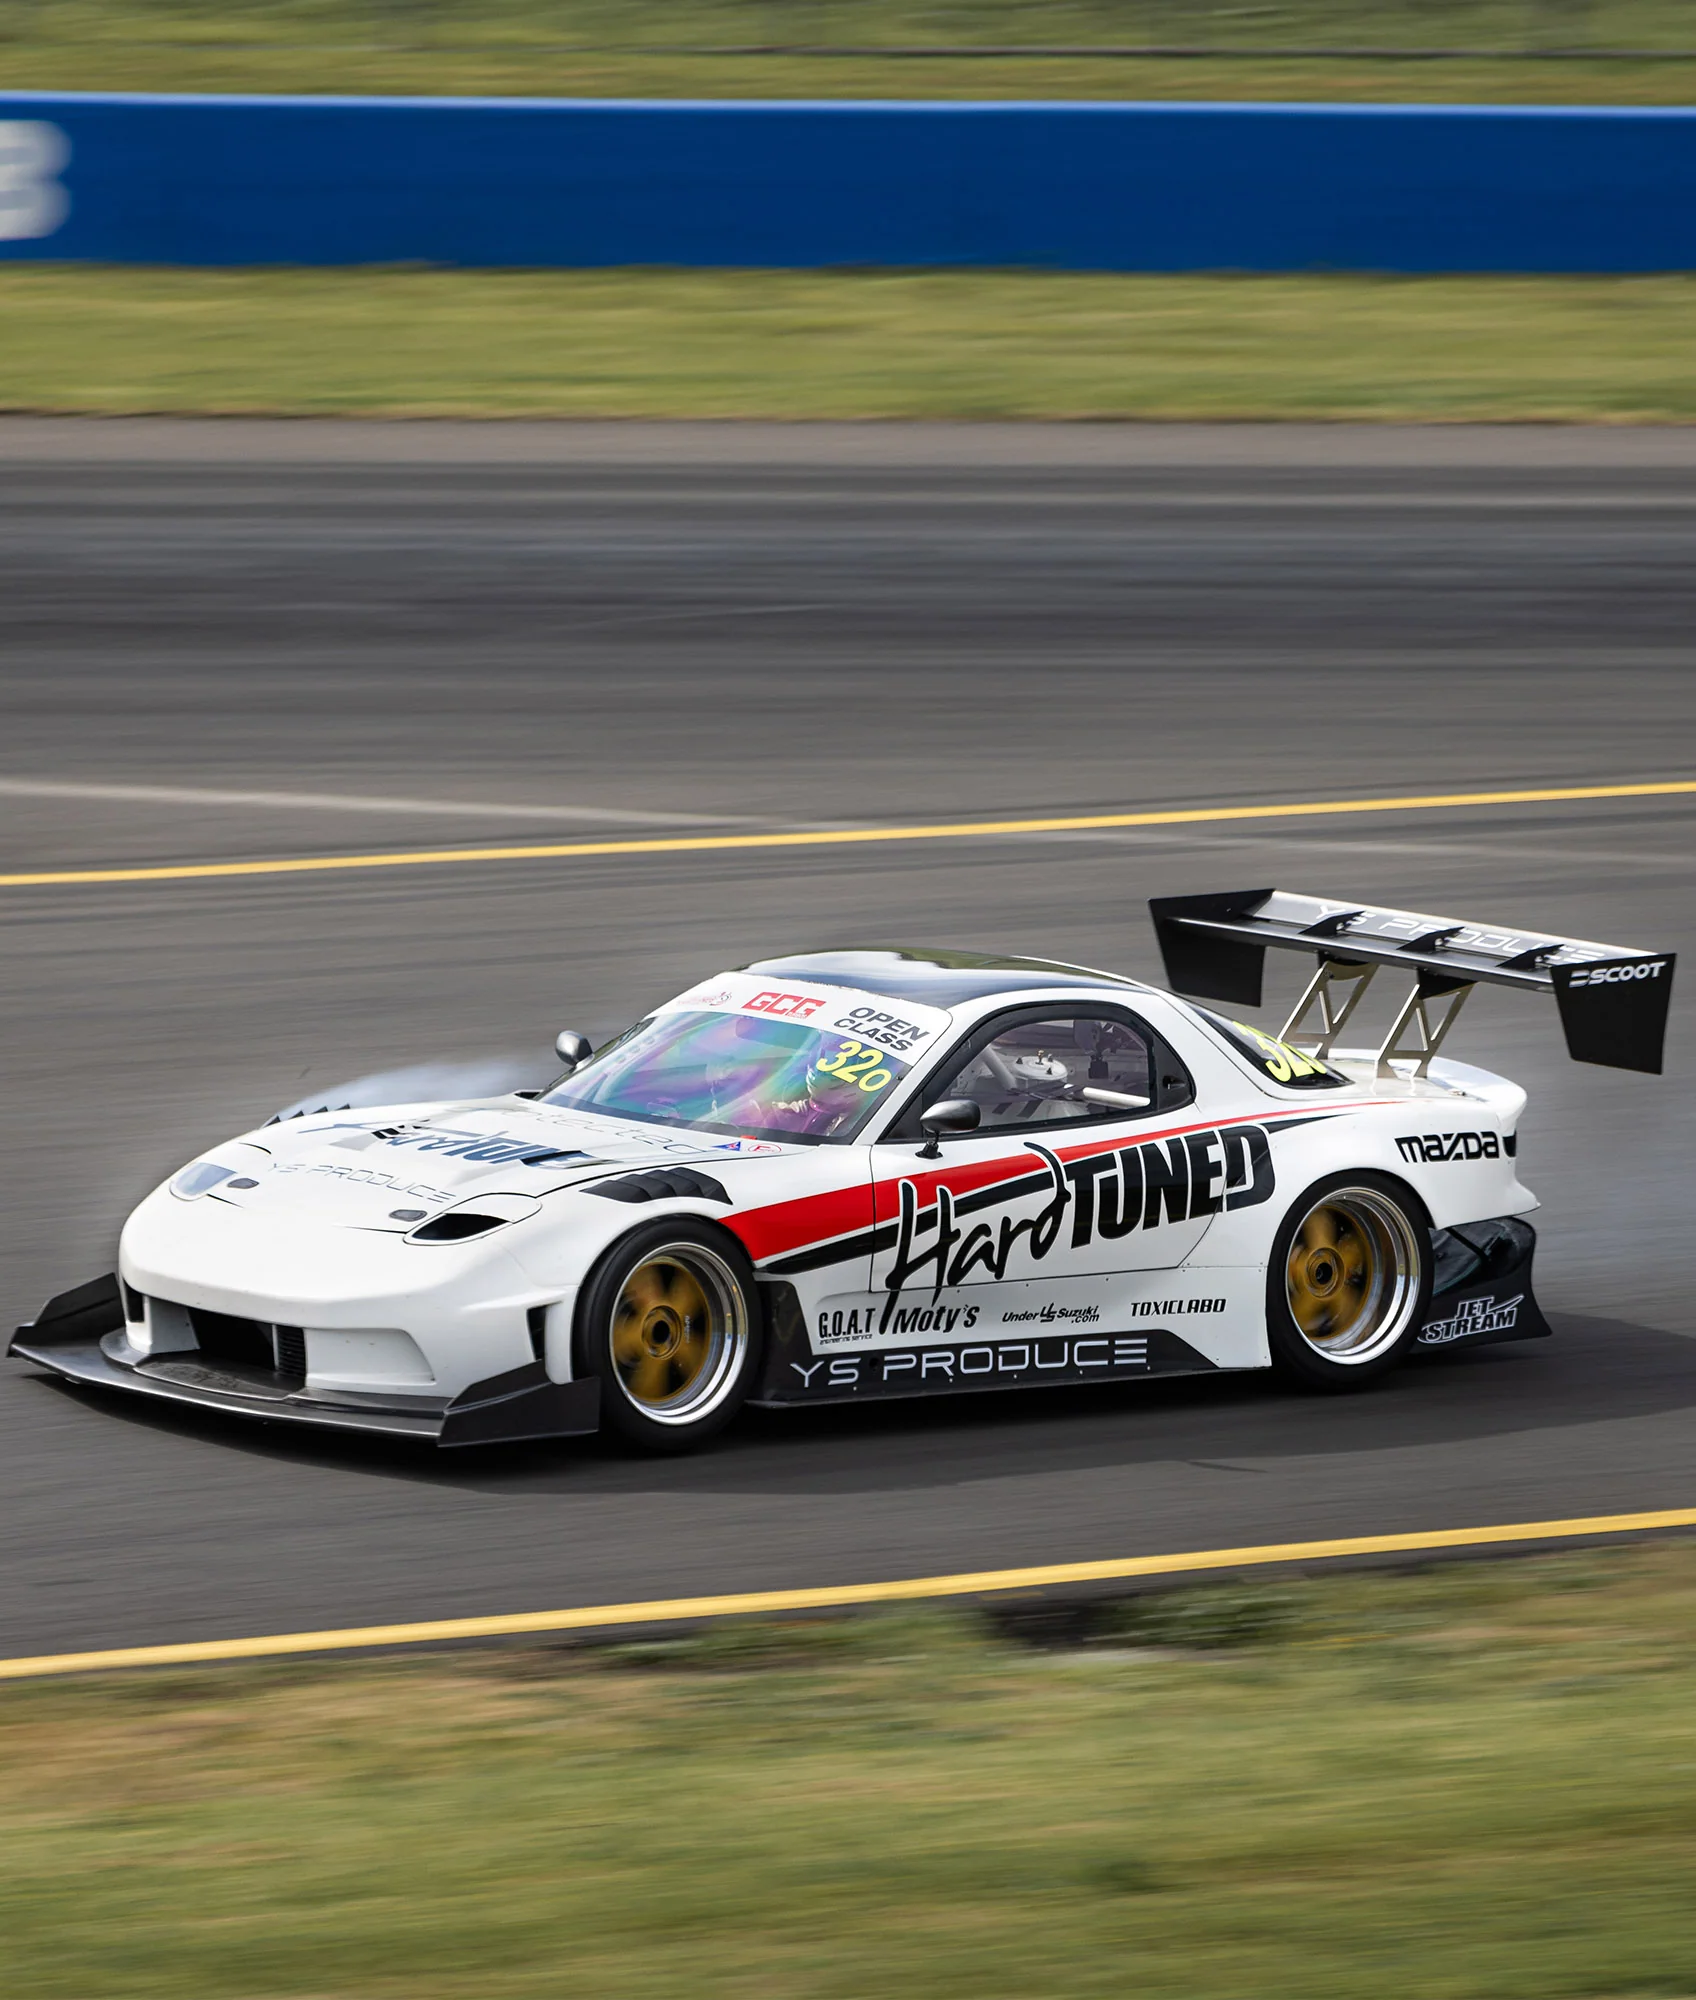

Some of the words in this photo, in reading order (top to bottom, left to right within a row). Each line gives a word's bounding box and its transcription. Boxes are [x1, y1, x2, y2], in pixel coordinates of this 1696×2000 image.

[741, 991, 827, 1019] GCG
[833, 1018, 913, 1051] CLASS
[849, 1007, 930, 1041] OPEN
[816, 1040, 892, 1092] 320
[307, 1164, 456, 1204] PRODUCE
[1131, 1298, 1227, 1317] TOXICLABO
[1422, 1307, 1517, 1341] STREAM
[1455, 1295, 1495, 1320] JET
[789, 1357, 861, 1388] YS
[882, 1338, 1148, 1381] PRODUCE
